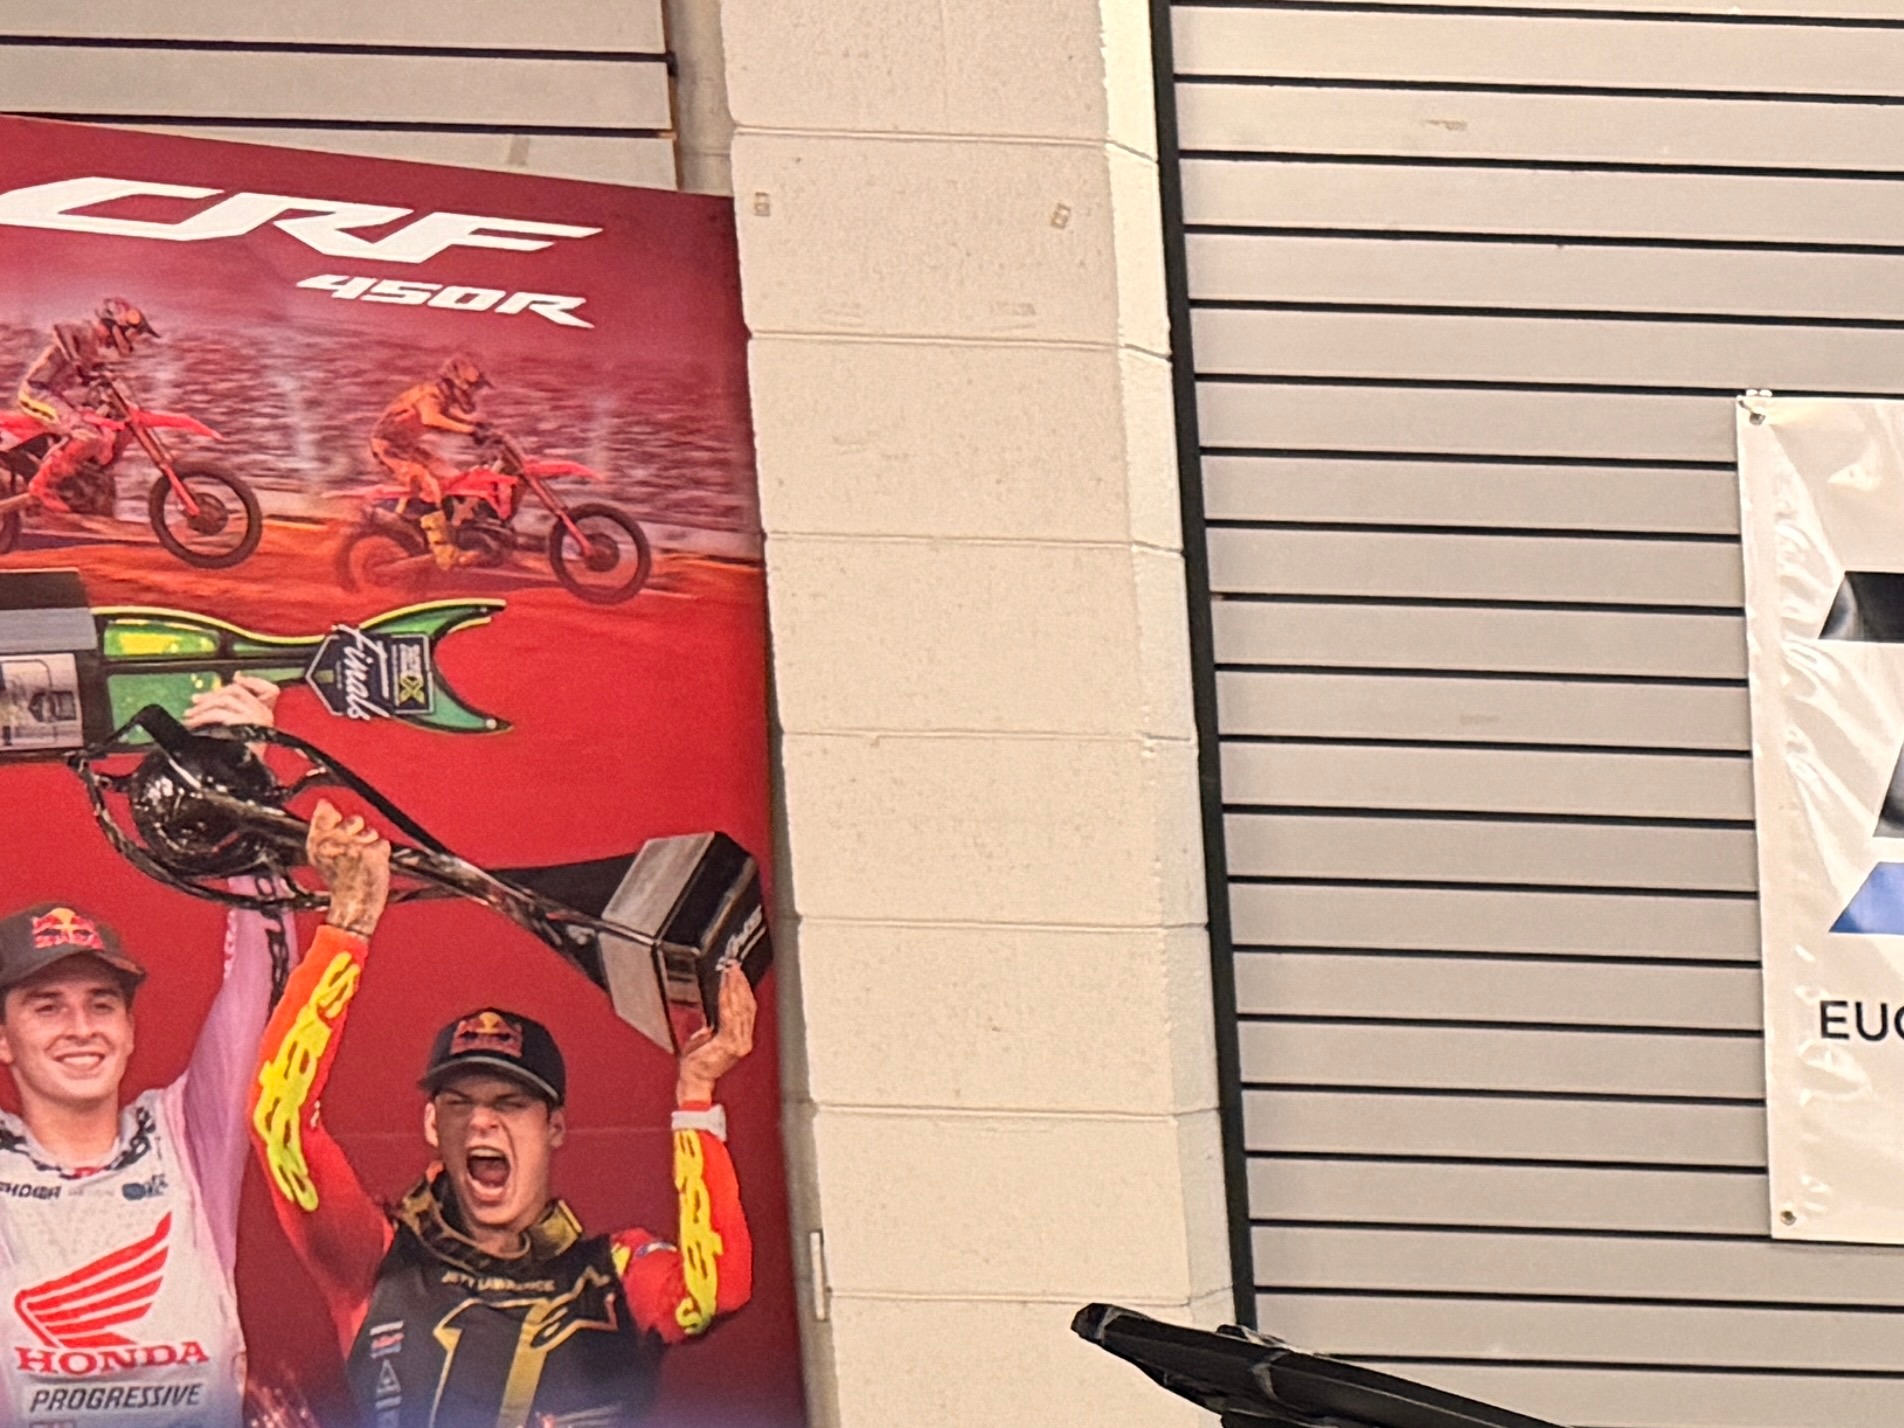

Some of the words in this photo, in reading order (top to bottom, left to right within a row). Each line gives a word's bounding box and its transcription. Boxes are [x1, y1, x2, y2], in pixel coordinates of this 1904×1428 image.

[0, 176, 603, 263] CRF
[296, 274, 594, 328] 450R
[14, 1341, 209, 1376] HONDA
[29, 1382, 203, 1413] PROGRESSIVE
